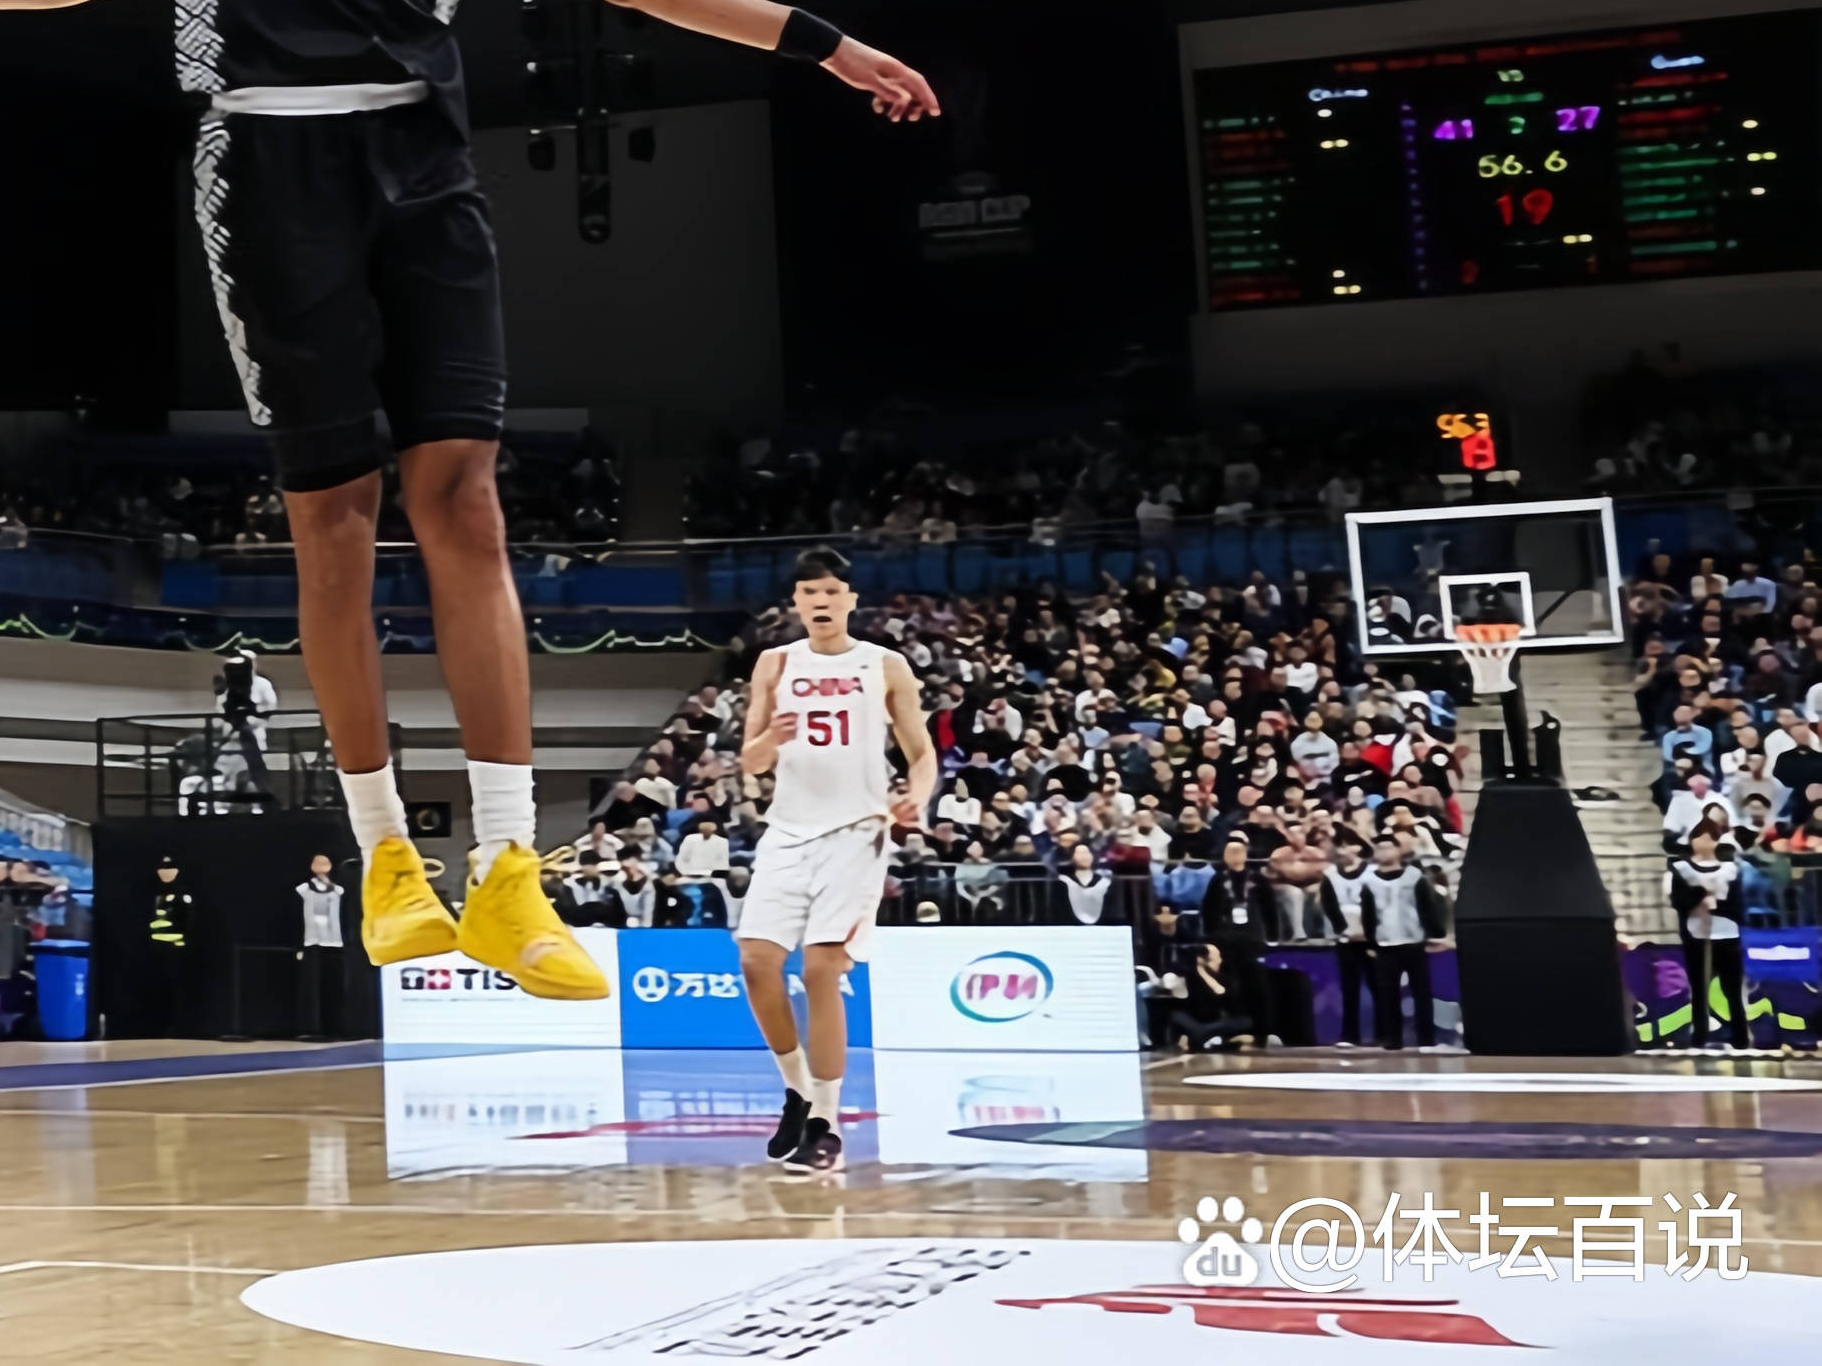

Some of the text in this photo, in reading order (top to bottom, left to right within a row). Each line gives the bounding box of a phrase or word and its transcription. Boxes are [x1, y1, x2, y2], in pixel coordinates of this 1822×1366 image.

[1555, 105, 1601, 132] 27
[1495, 188, 1554, 226] 19
[807, 710, 849, 746] 51
[456, 968, 520, 990] TIS
